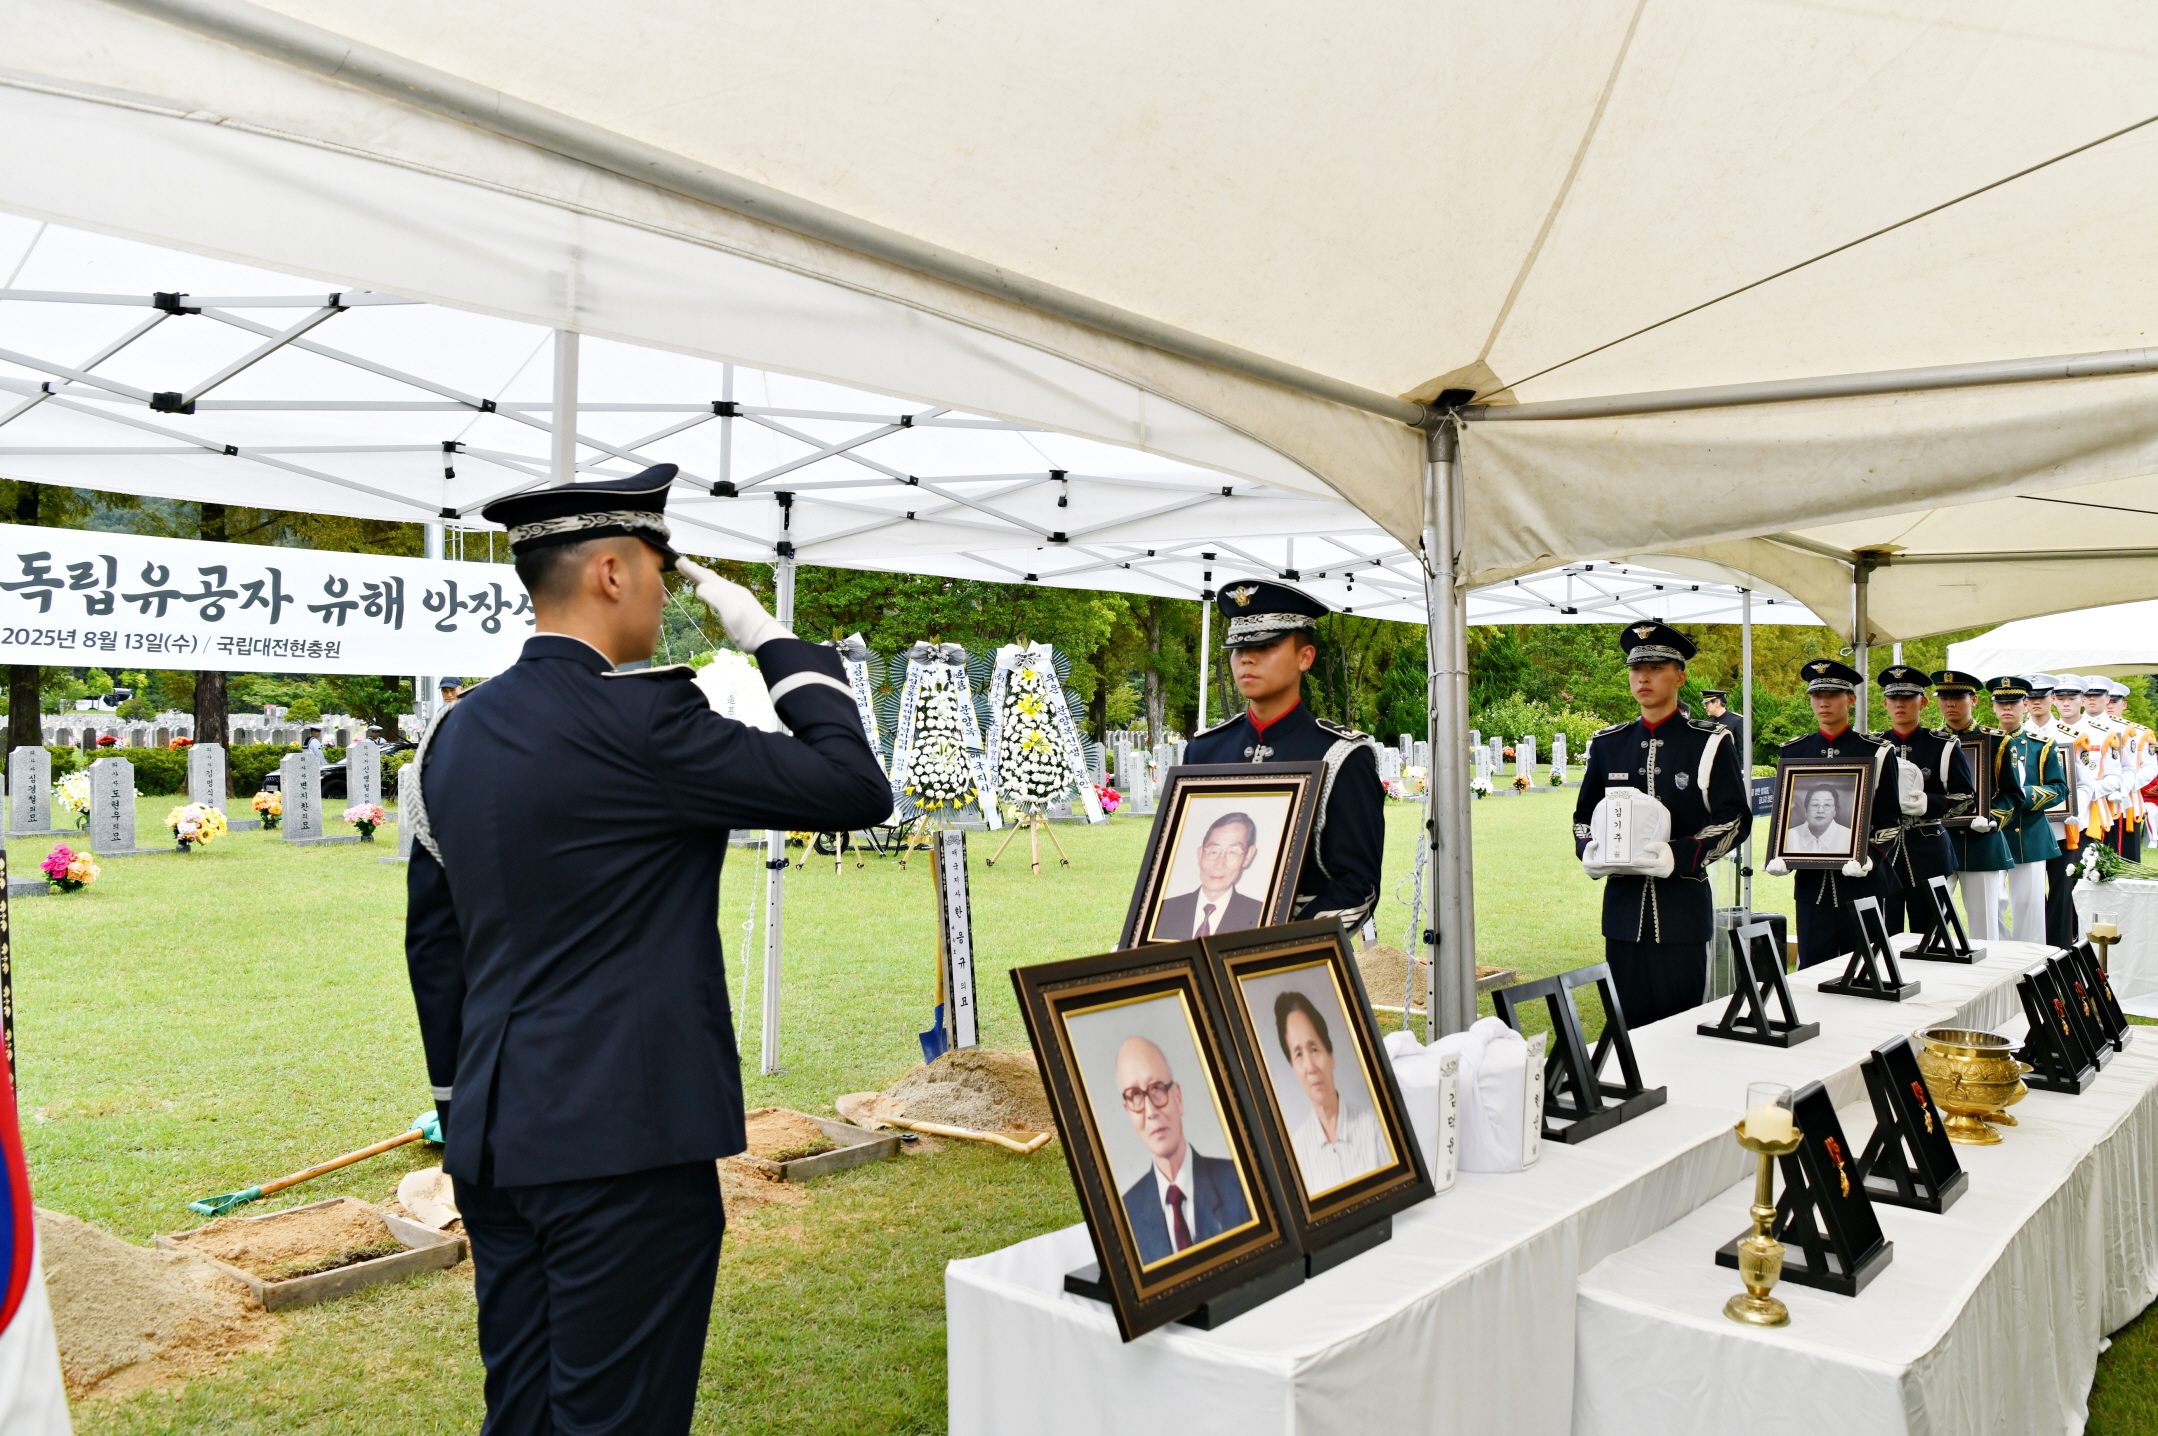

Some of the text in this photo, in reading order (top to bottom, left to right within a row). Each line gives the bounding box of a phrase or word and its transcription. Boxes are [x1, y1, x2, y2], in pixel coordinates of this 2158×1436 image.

[0, 551, 294, 625] 독립유공자
[307, 573, 405, 631] 유해
[1, 627, 76, 650] 2025년
[83, 630, 118, 652] 8월
[124, 632, 198, 654] 13일(수)
[216, 635, 341, 659] 국립대전현충원
[1613, 807, 1623, 843] 김기주
